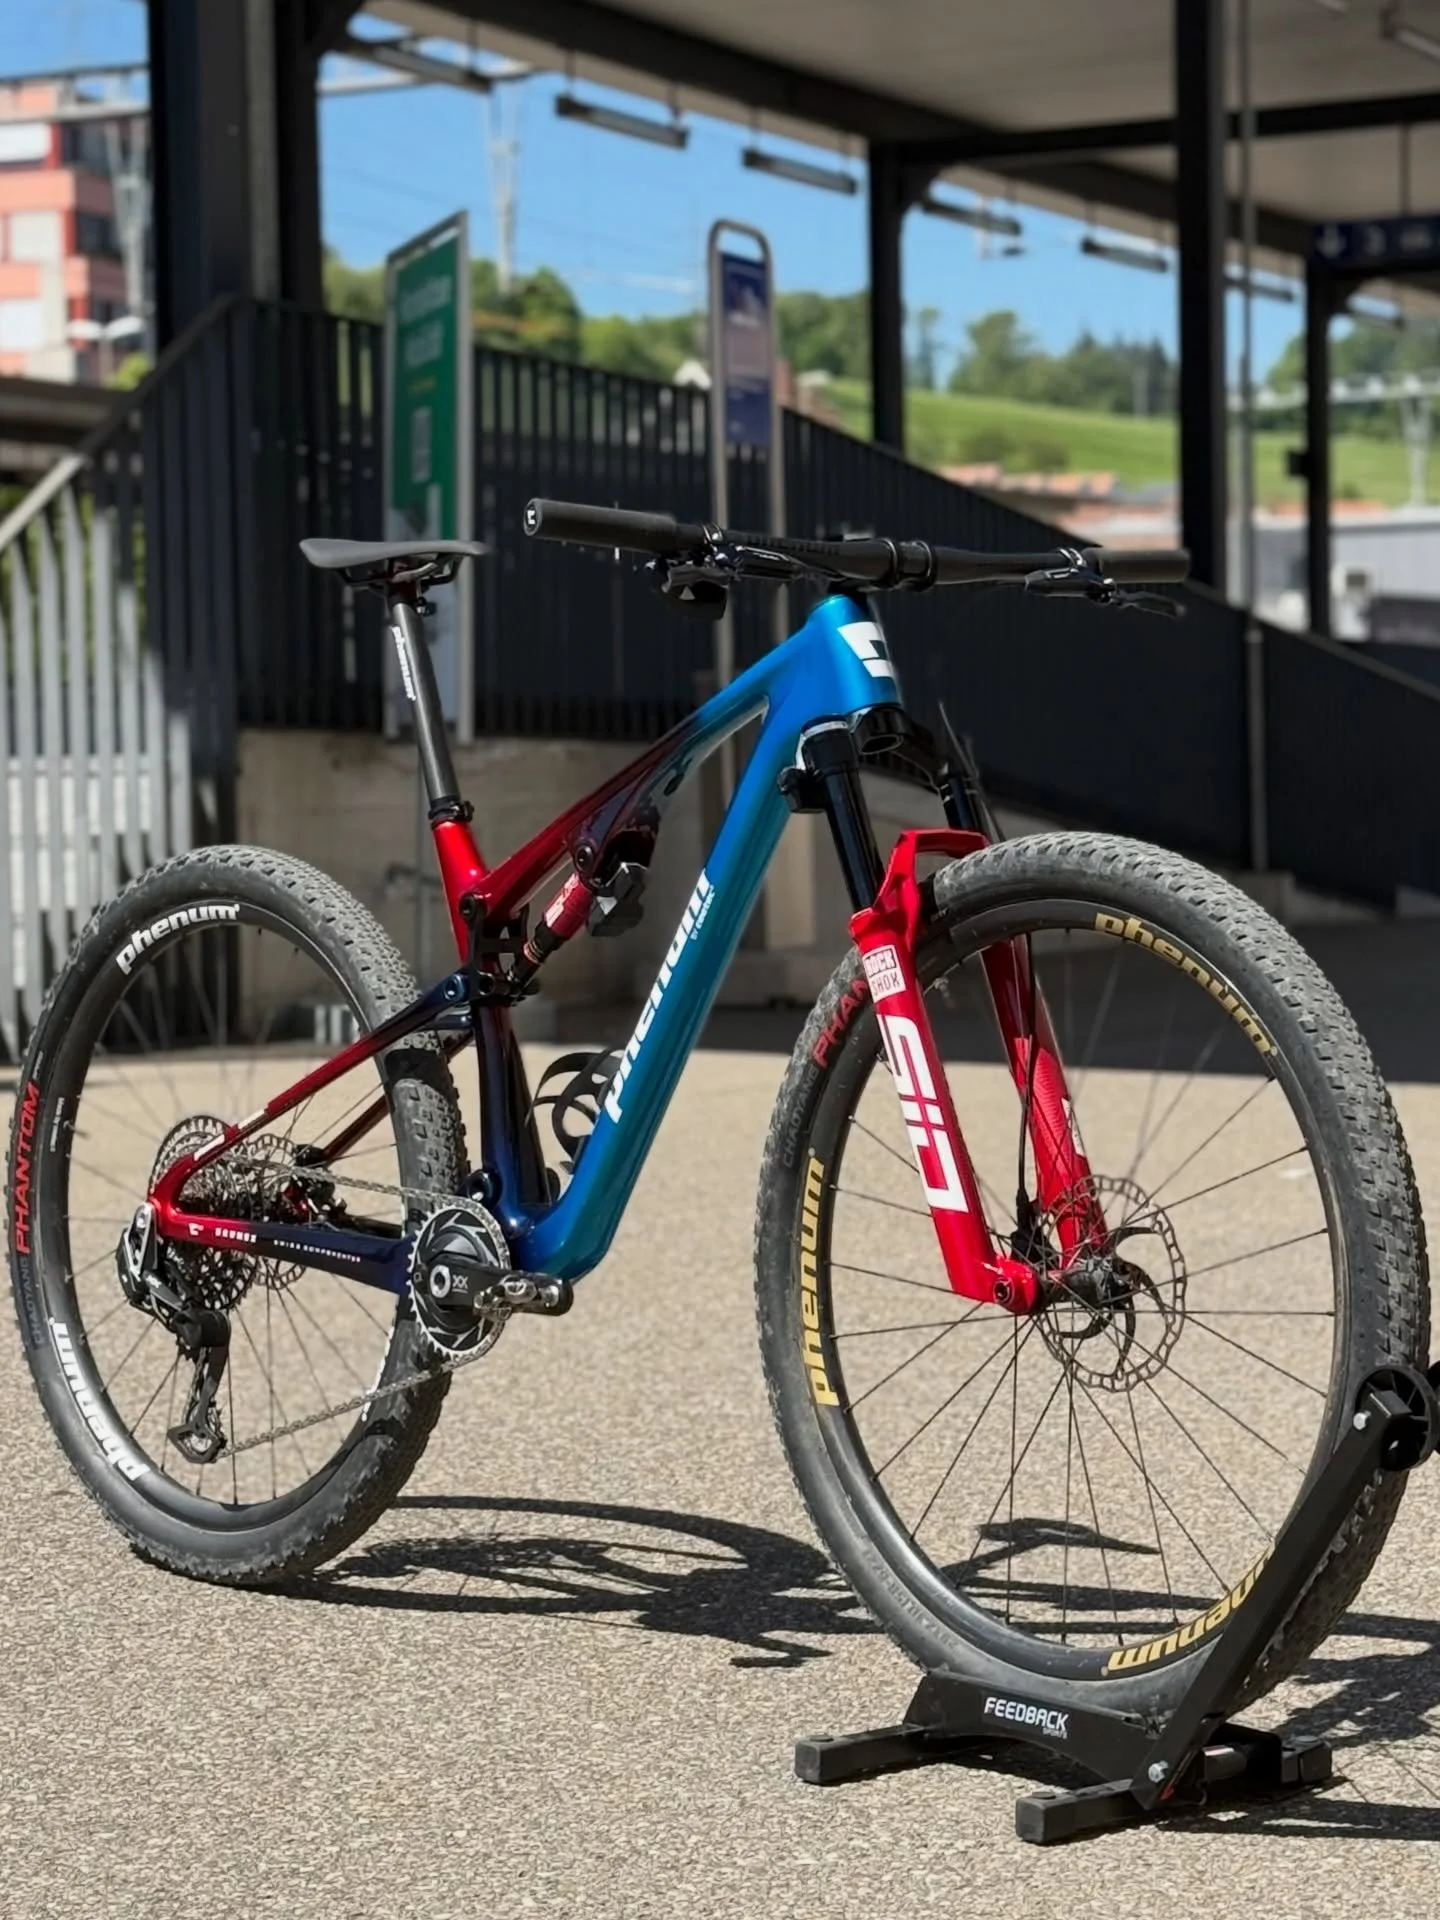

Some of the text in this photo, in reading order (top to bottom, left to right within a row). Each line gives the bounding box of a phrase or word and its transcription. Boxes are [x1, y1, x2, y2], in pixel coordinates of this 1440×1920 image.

[115, 903, 240, 975] phenum
[862, 947, 897, 978] ROCK
[812, 979, 869, 1069] PHAN
[869, 970, 901, 997] SHOX
[1095, 912, 1277, 1056] phenum
[15, 1082, 40, 1254] PHANTOM
[452, 1274, 469, 1289] XX
[799, 1147, 840, 1406] phenum
[49, 1317, 151, 1481] phenum
[983, 1696, 1070, 1731] FEEDBACK
